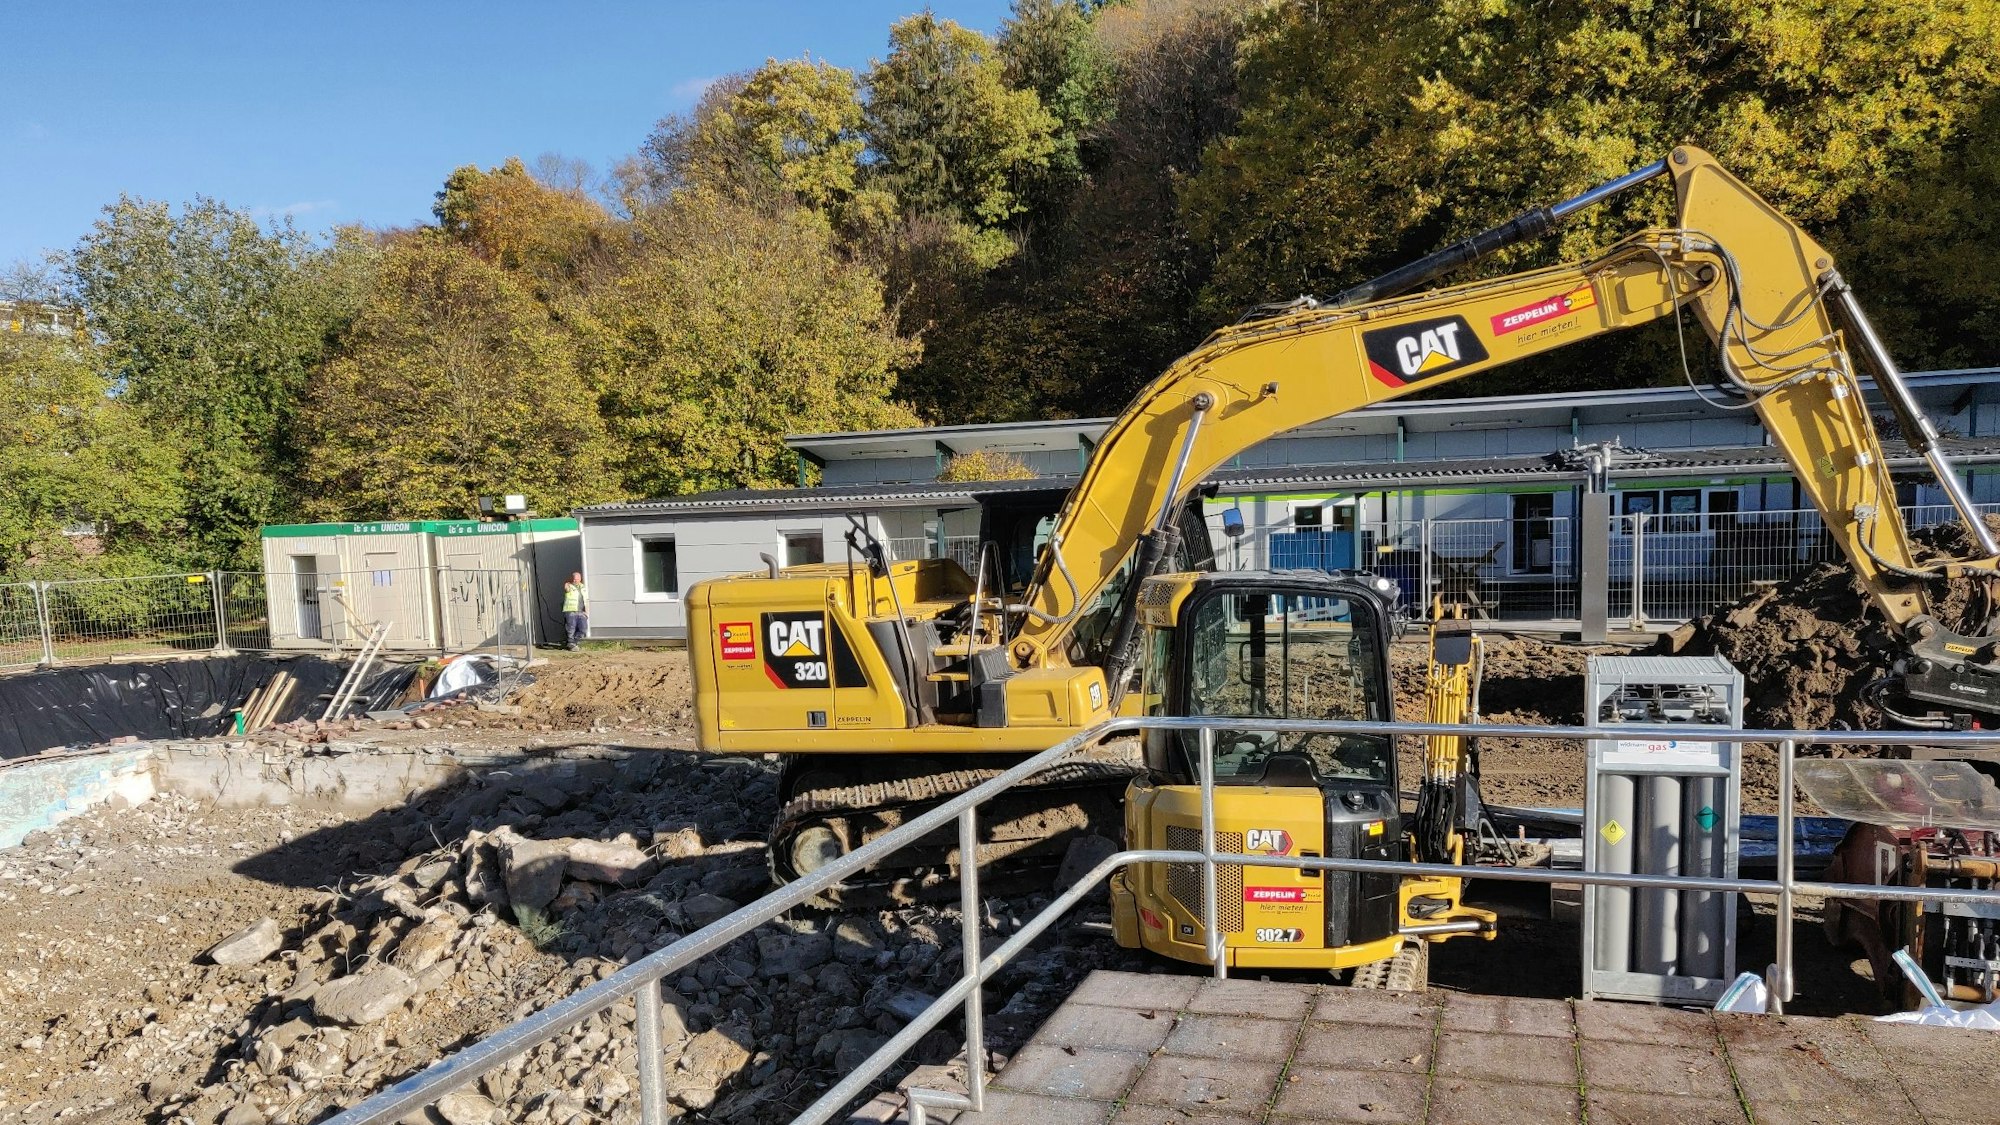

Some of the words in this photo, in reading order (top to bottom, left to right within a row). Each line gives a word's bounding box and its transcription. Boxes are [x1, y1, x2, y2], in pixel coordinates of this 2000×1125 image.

[1503, 302, 1559, 327] ZEPPELIN
[1517, 331, 1536, 344] hier
[1396, 322, 1460, 376] CAT
[381, 522, 410, 531] UNICON
[477, 523, 508, 533] UNICON
[769, 620, 823, 657] CAT
[724, 646, 753, 654] ZEPPELIN
[794, 661, 827, 681] 320
[1648, 743, 1667, 753] gas
[1246, 829, 1283, 852] CAT
[1253, 890, 1297, 899] ZEPPELIN
[1260, 903, 1275, 911] hier
[1256, 927, 1297, 942] 302.7
